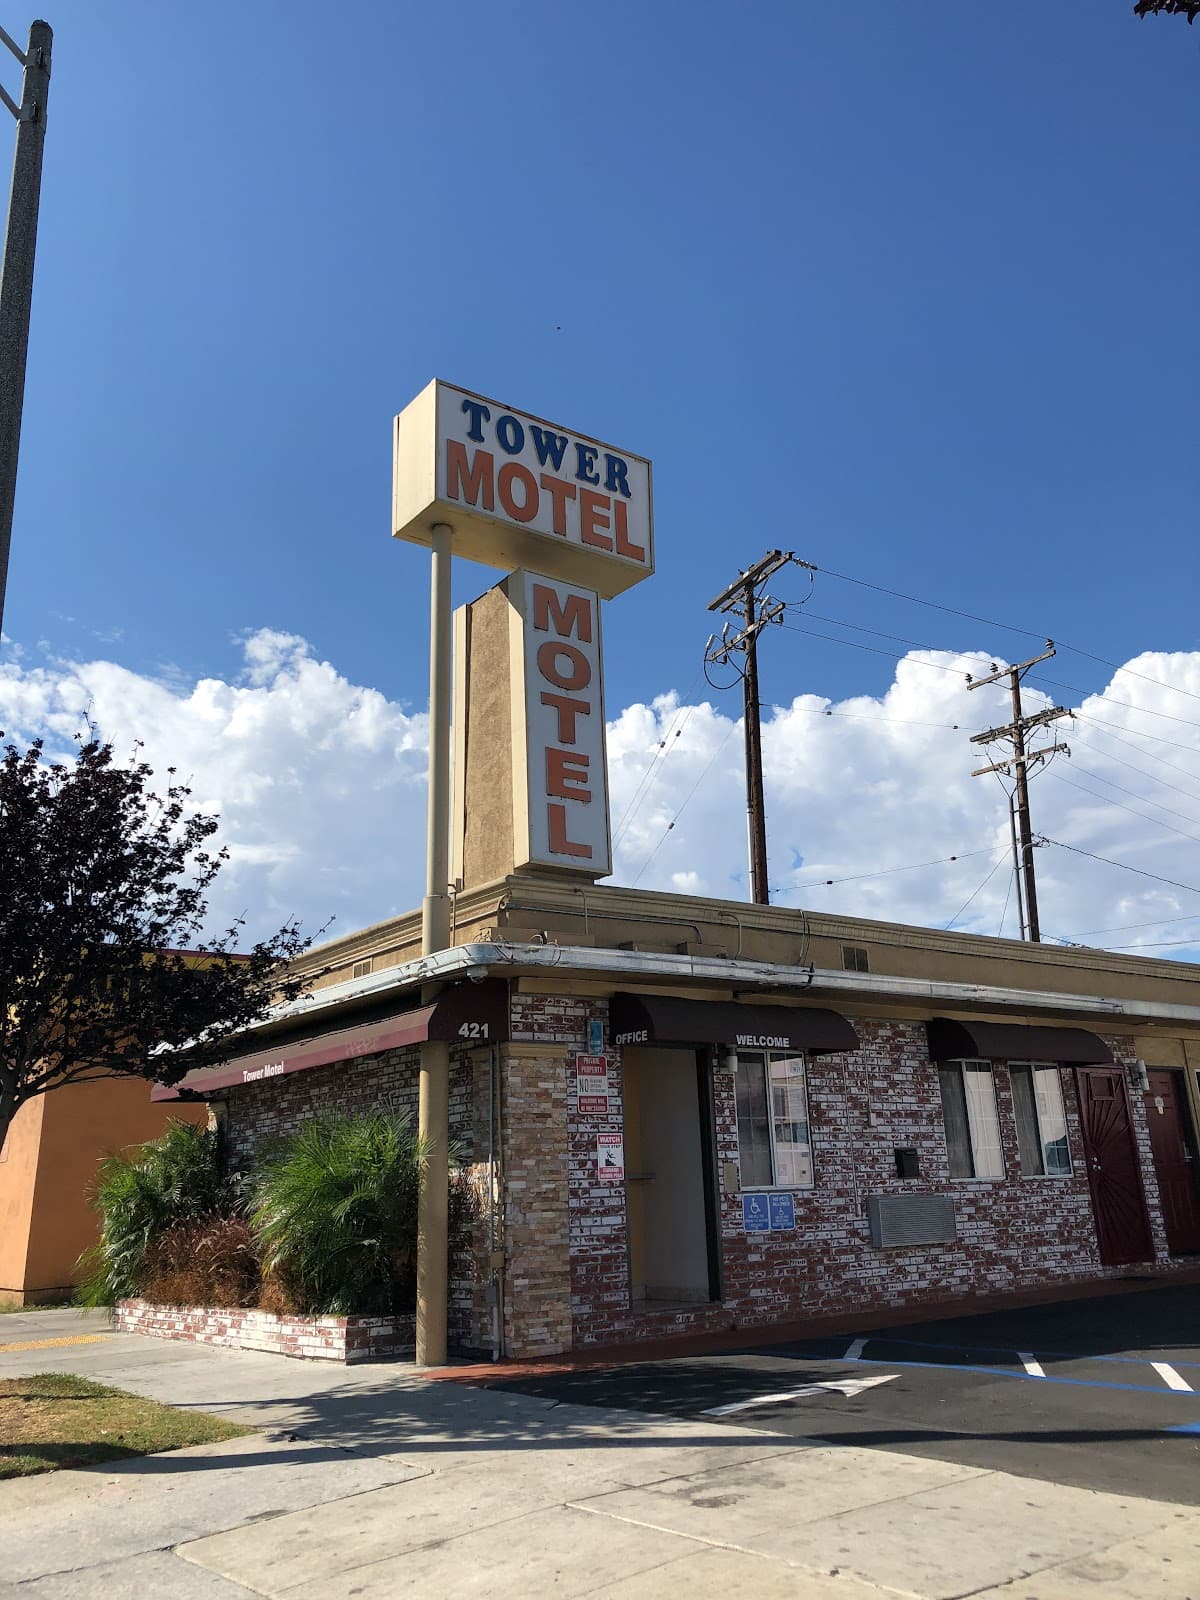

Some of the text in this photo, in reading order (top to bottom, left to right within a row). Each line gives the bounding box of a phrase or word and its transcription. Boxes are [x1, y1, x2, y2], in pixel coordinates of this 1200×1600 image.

[462, 399, 632, 499] TOWER
[446, 439, 646, 562] MOTEL
[533, 583, 593, 858] MOTEL
[458, 1022, 490, 1039] 421
[615, 1030, 648, 1045] OFFICE
[735, 1034, 790, 1048] WELCOME
[243, 1061, 284, 1083] Tower Motel
[579, 1078, 589, 1092] NO
